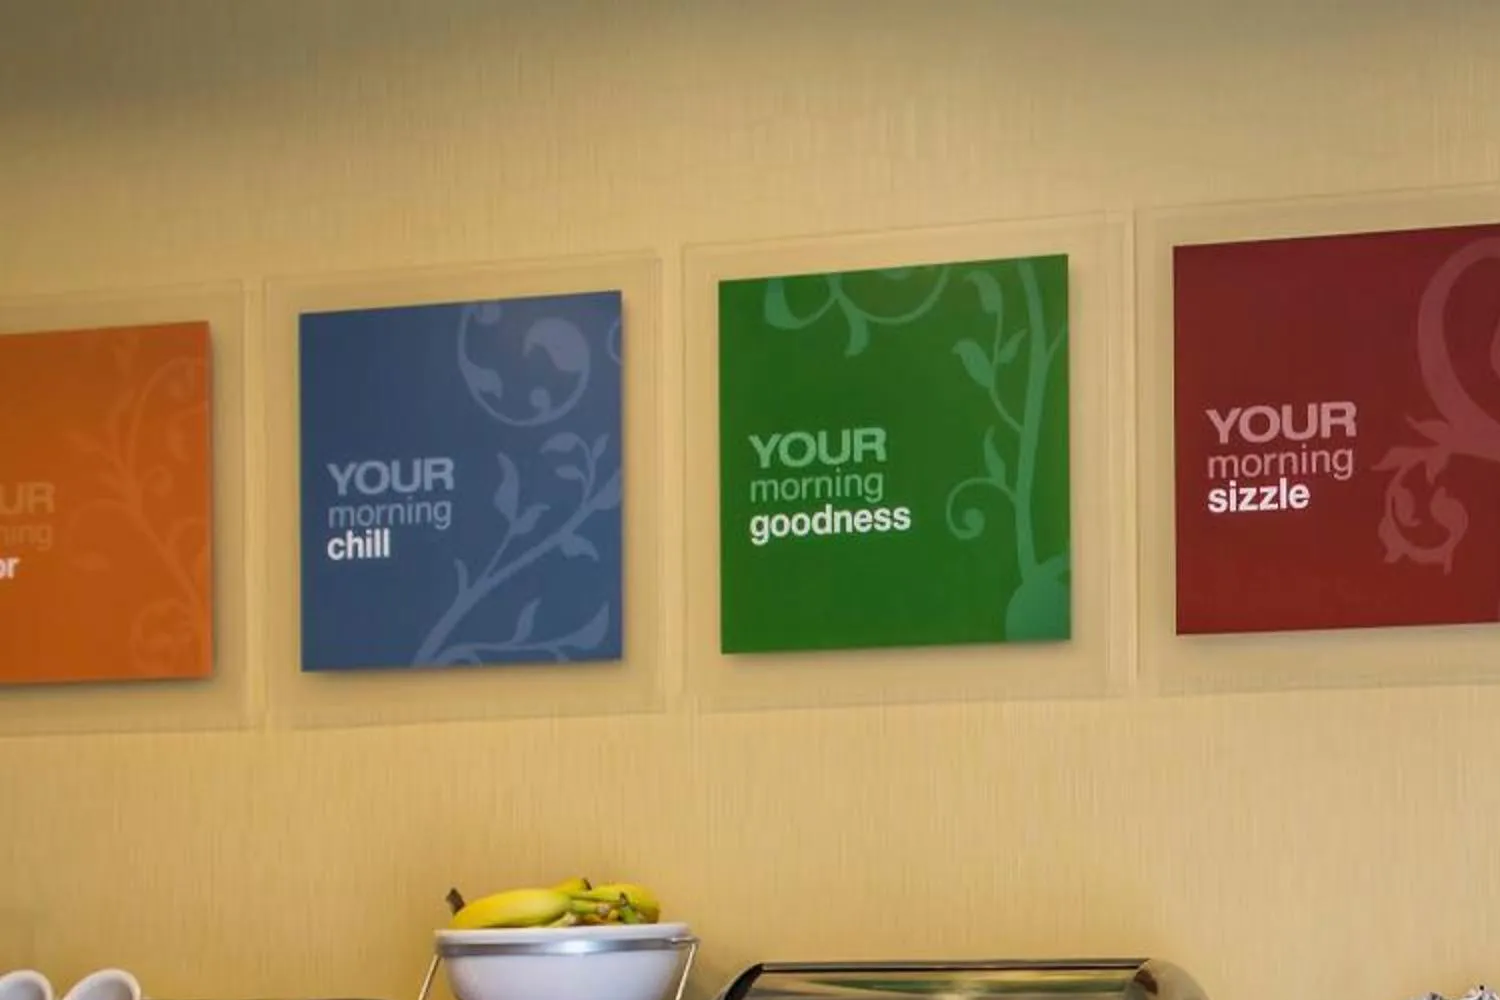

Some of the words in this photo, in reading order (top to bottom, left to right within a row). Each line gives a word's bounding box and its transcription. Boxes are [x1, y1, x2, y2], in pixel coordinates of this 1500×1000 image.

[1205, 401, 1357, 444] YOUR
[748, 427, 887, 469] YOUR
[1208, 443, 1353, 480] morning
[327, 456, 454, 496] YOUR
[751, 466, 884, 503] morning
[328, 496, 452, 530] morning
[1208, 477, 1310, 513] sizzle
[750, 503, 912, 546] goodness
[327, 528, 390, 560] chill
